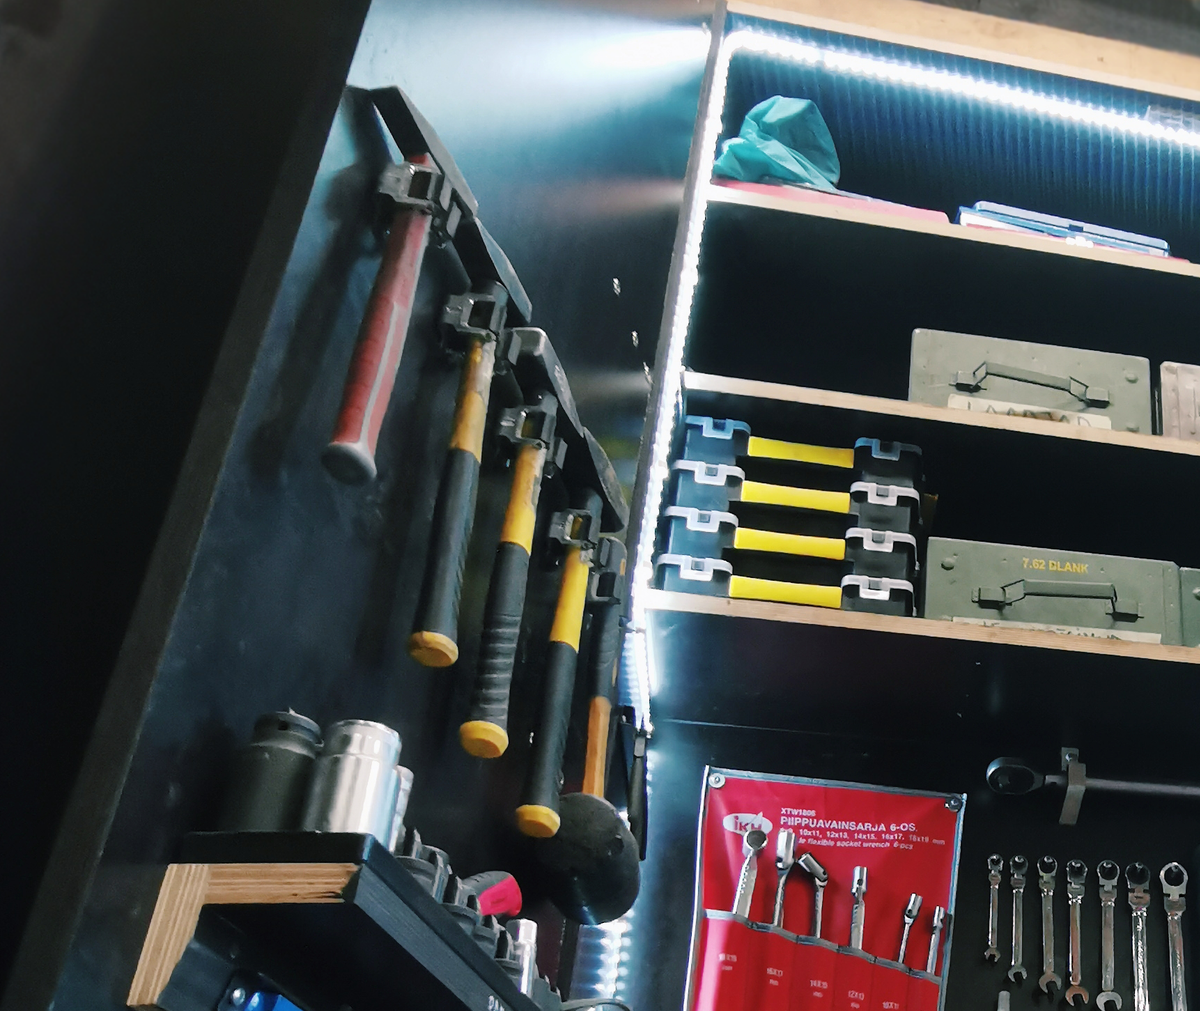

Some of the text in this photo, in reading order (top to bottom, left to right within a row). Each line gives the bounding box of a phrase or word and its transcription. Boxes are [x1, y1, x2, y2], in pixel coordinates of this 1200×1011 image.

[1022, 556, 1089, 574] 7.62 BLANK
[780, 816, 887, 832] PIIPPUAVAINSARJA
